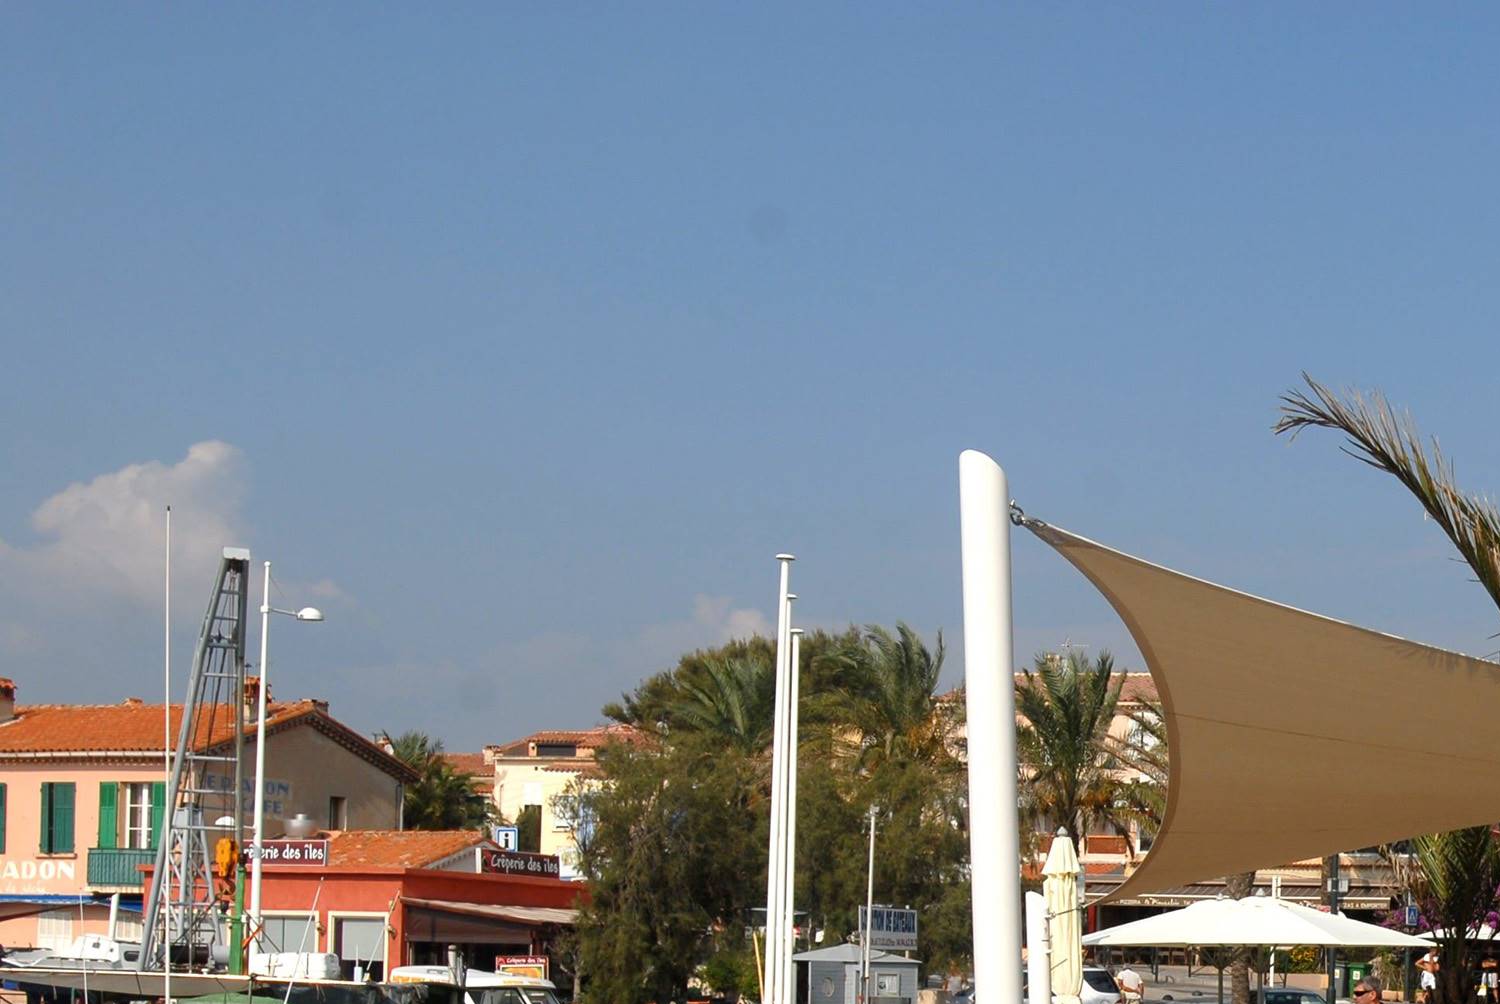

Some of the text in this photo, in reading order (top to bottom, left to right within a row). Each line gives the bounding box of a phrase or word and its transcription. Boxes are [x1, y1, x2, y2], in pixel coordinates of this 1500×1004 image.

[282, 843, 301, 860] des
[490, 854, 525, 874] Crêperie
[527, 856, 541, 872] des
